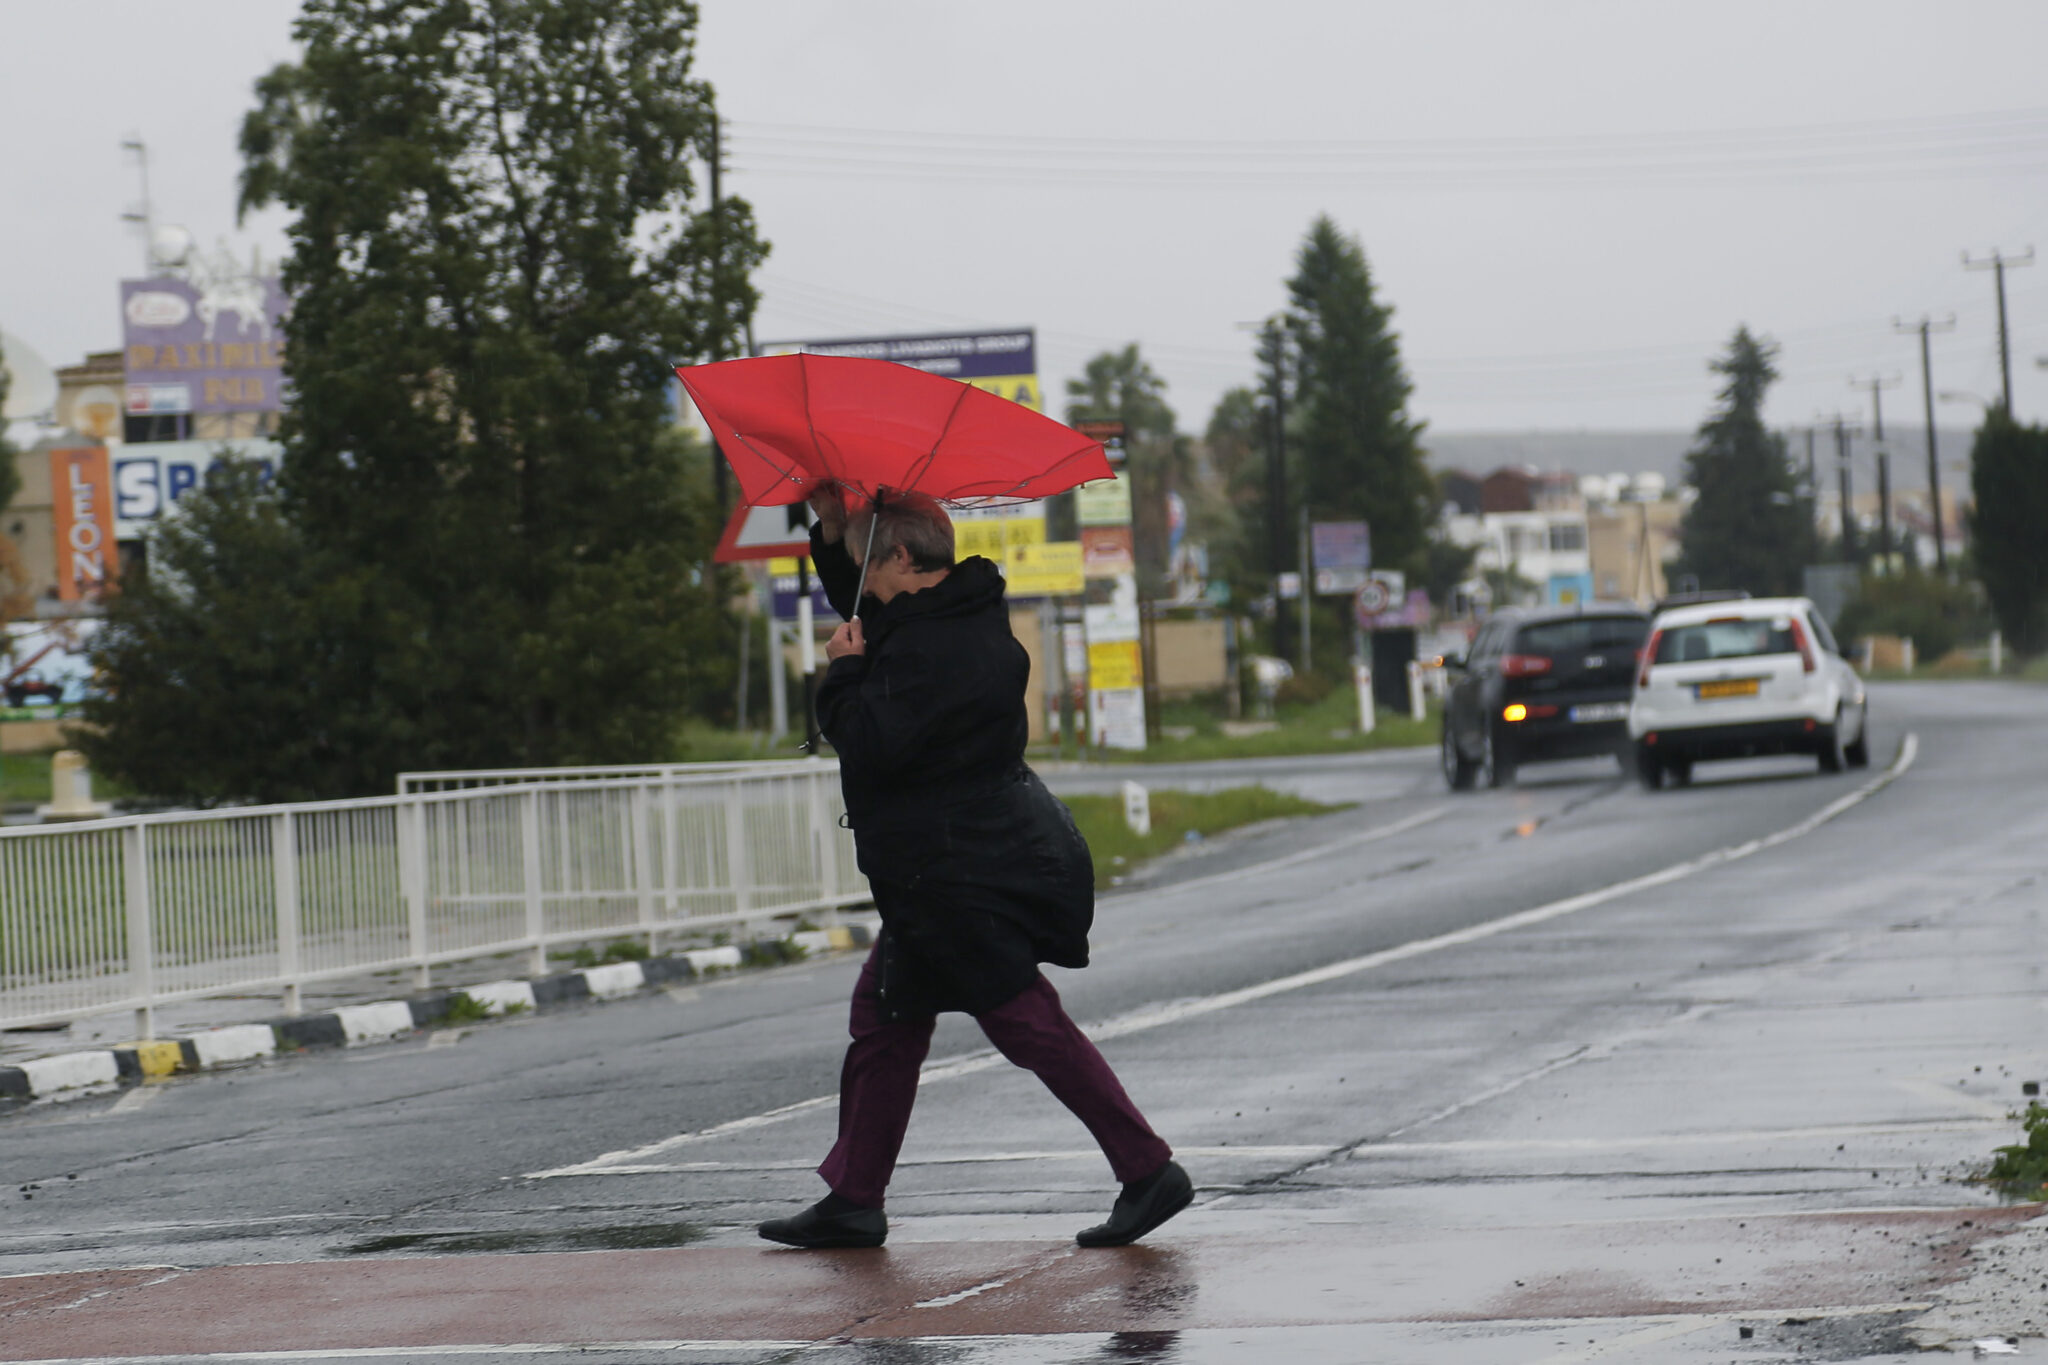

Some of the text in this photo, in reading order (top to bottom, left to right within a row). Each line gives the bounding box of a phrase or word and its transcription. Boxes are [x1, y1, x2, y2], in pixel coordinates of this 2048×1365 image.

[974, 335, 1029, 354] GROUP
[204, 379, 265, 404] PUB
[69, 463, 104, 580] LEON
